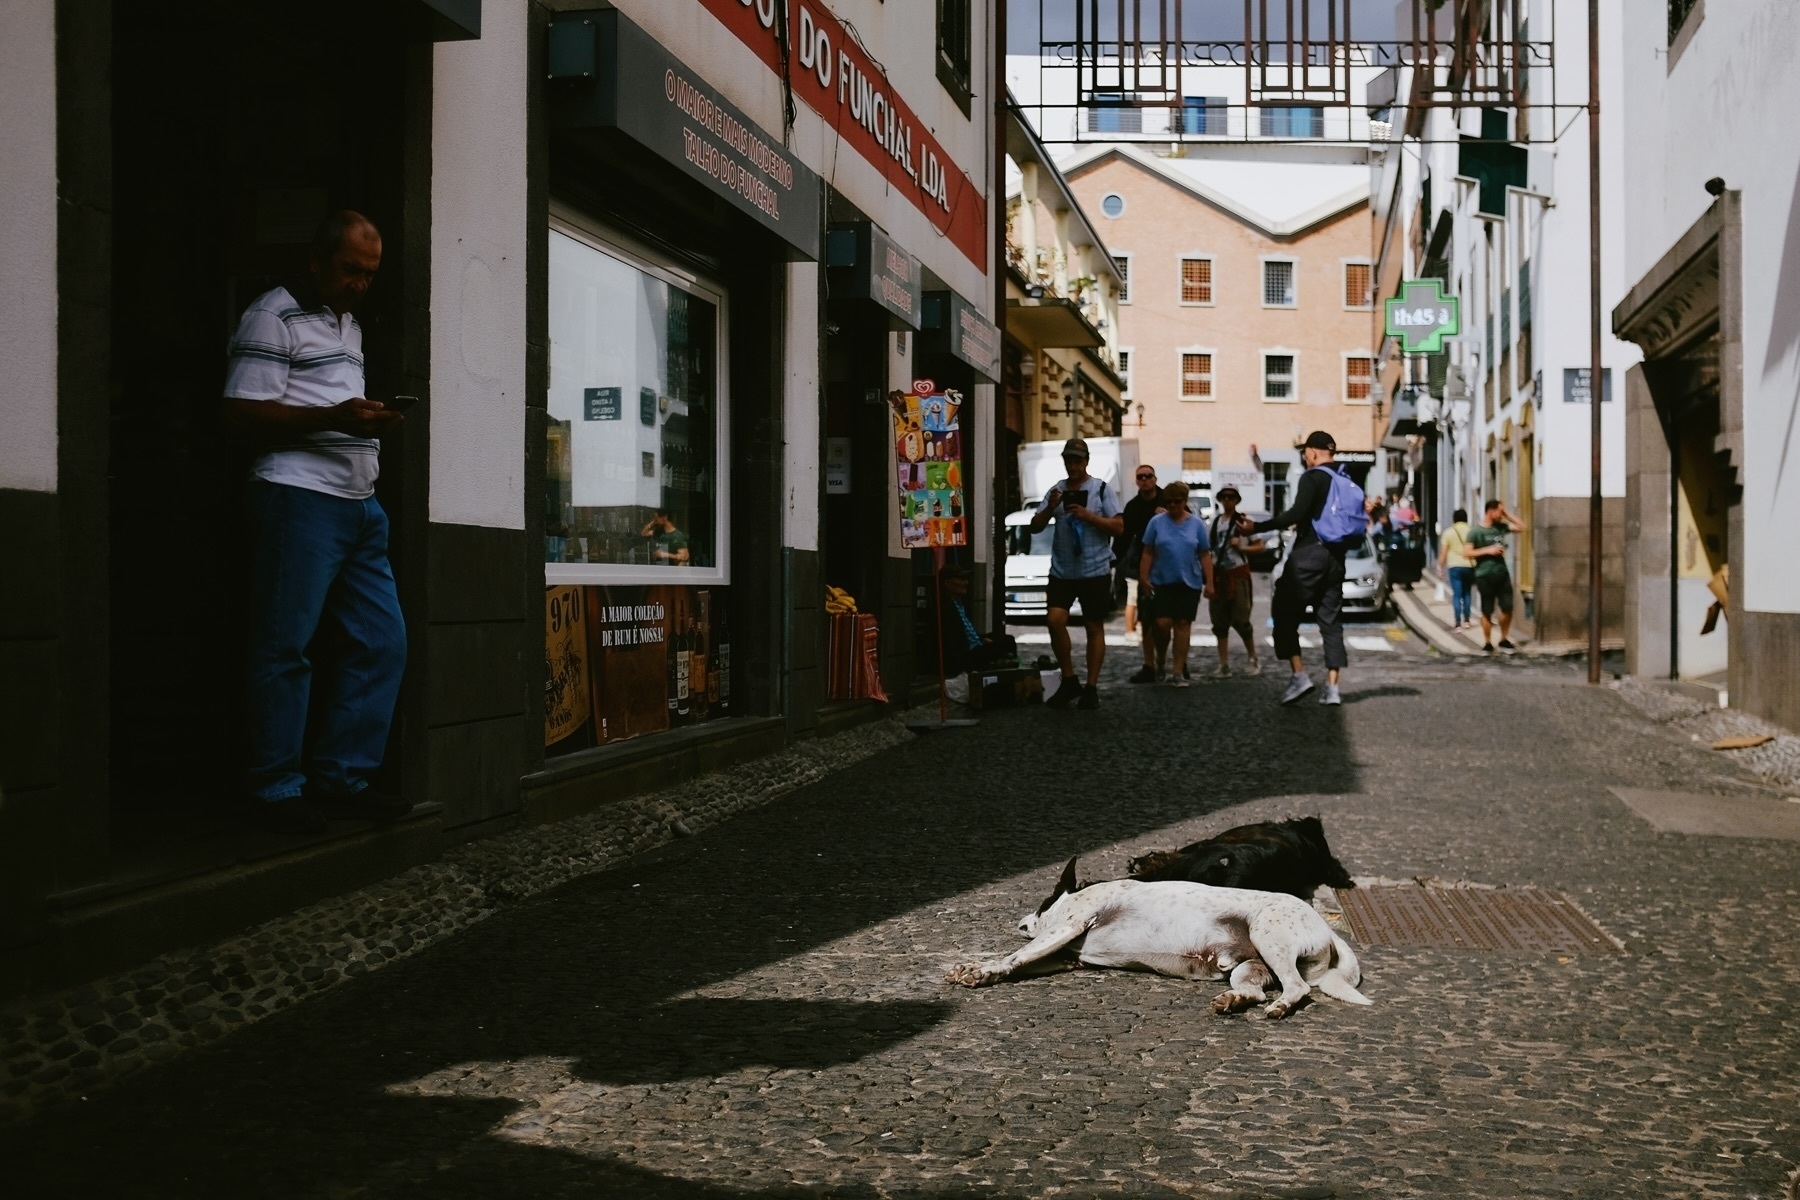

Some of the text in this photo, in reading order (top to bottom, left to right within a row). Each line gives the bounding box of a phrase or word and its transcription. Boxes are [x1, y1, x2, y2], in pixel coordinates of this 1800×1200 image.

[664, 68, 793, 190] O MAIOR E MAIS MODERNO
[799, 4, 832, 88] DO
[920, 143, 950, 213] LDA.
[683, 127, 779, 221] TALHO DO FUNCHAL
[600, 601, 665, 625] A MAIOR COLEÇÃO
[602, 625, 664, 647] DE RUM É NOSSA!
